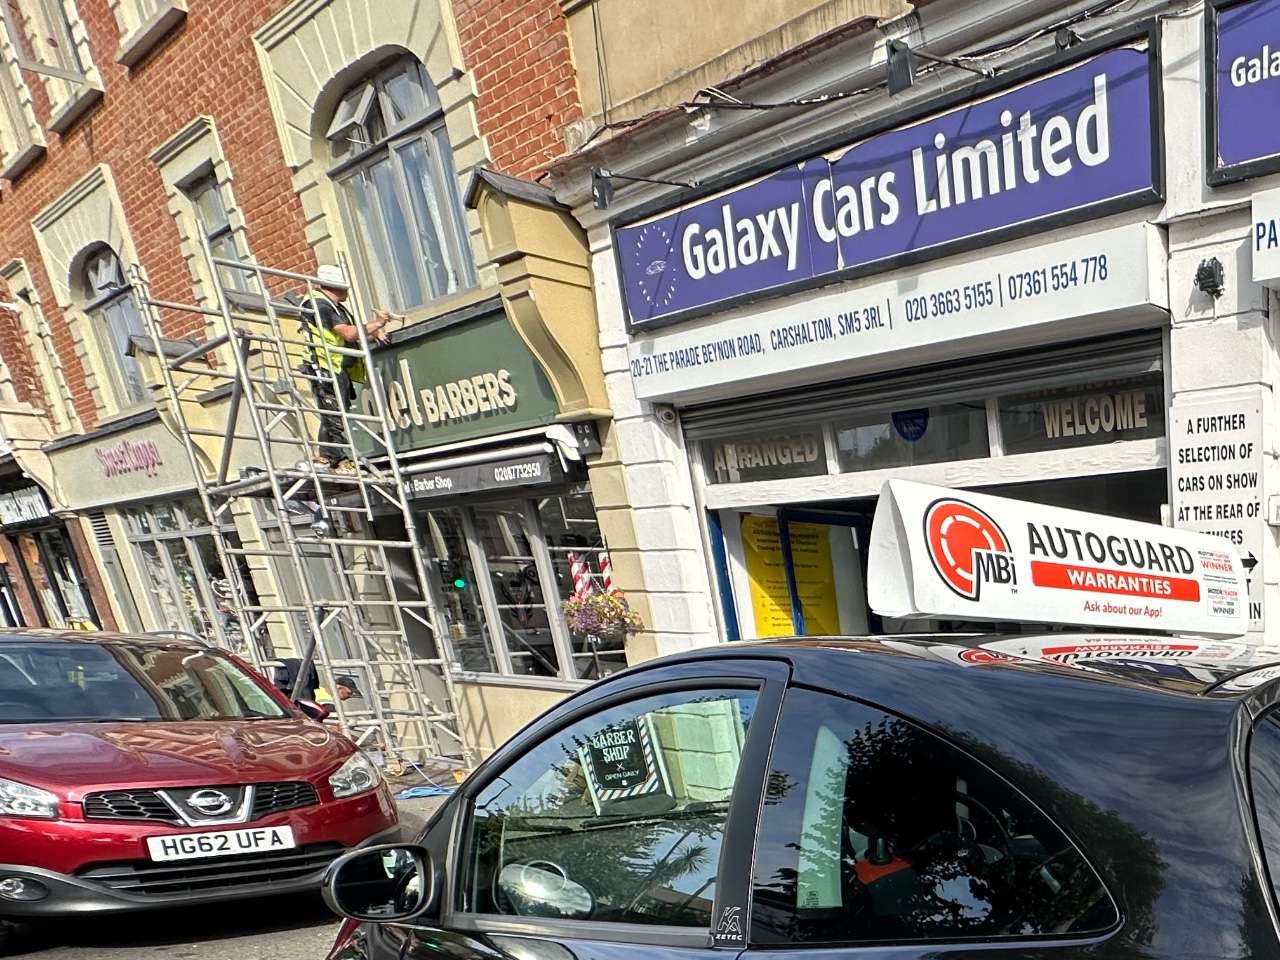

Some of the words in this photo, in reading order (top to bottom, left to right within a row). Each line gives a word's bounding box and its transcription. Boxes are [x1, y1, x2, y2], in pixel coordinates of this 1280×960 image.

[682, 201, 800, 280] Galaxy
[813, 169, 900, 243] Cars
[911, 73, 1111, 216] Limited
[631, 358, 654, 378] 20-21
[653, 354, 670, 373] THE
[670, 346, 702, 370] PARADE
[701, 339, 737, 364] BEYNON
[737, 333, 766, 355] ROAD,
[770, 316, 837, 351] CARSHALTON,
[838, 308, 862, 335] SM5
[863, 305, 885, 331] 3RL
[905, 296, 928, 322] 020
[930, 288, 961, 317] 3663
[963, 281, 994, 310] 5155
[1008, 268, 1048, 300] 07361
[1051, 260, 1078, 291] 554
[1081, 253, 1108, 285] 778
[420, 369, 518, 423] BARBERS
[1042, 391, 1148, 438] WELCOME
[1187, 418, 1194, 435] A
[1197, 413, 1246, 434] FURTHER
[1178, 444, 1236, 464] SELECTION
[1239, 442, 1254, 459] OF
[435, 475, 453, 490] Shop
[1178, 474, 1205, 492] CARS
[1208, 473, 1223, 490] ON
[1226, 472, 1258, 489] SHOW
[1178, 506, 1190, 522] AT
[1193, 505, 1213, 521] THE
[1216, 503, 1243, 519] REAR
[1247, 502, 1260, 518] OF
[1027, 522, 1195, 575] AUTOGUARD
[1200, 560, 1233, 572] WINNER
[1066, 567, 1172, 596] WARRANTIES
[1083, 600, 1101, 613] Ask
[1103, 602, 1127, 615] about
[1128, 606, 1143, 616] our
[1144, 605, 1163, 619] App!
[592, 729, 636, 749] BARBER
[602, 745, 630, 763] SHOP
[604, 772, 622, 781] OPEN
[160, 834, 231, 857] HG62
[236, 829, 284, 849] UFA
[715, 933, 743, 941] ZETEC
